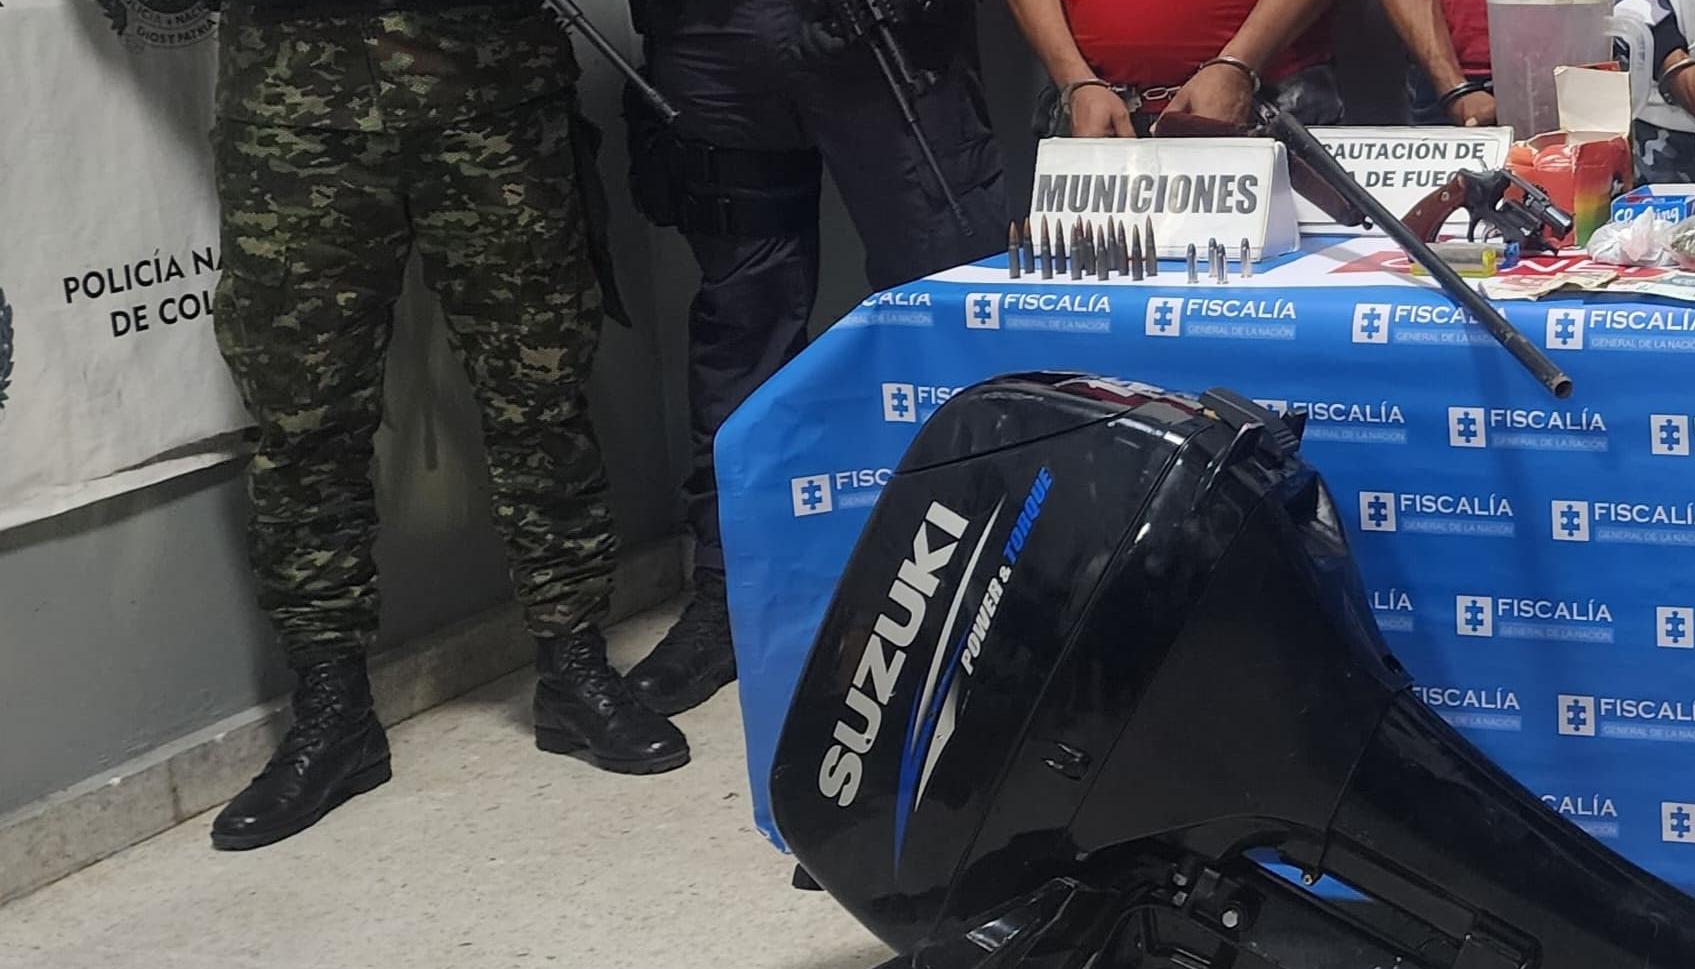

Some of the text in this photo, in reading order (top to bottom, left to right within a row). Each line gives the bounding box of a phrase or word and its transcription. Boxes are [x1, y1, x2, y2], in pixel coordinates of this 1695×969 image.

[1455, 143, 1485, 159] DE
[1365, 171, 1395, 187] DE
[1035, 173, 1258, 215] MUNICIONES
[63, 248, 186, 304] POLICÍA
[110, 290, 214, 338] DE COL
[1005, 291, 1111, 314] FISCALÍA
[1186, 296, 1296, 320] FISCALÍA
[1394, 303, 1507, 325] FISCAL
[1490, 407, 1606, 432] FISCALÍA
[1400, 493, 1513, 517] FISCALÍA
[960, 465, 1056, 676] POWER & TORQUE
[1370, 588, 1413, 612] LÍA
[1497, 597, 1613, 623] FISCALÍA
[818, 500, 970, 808] SUZUKI
